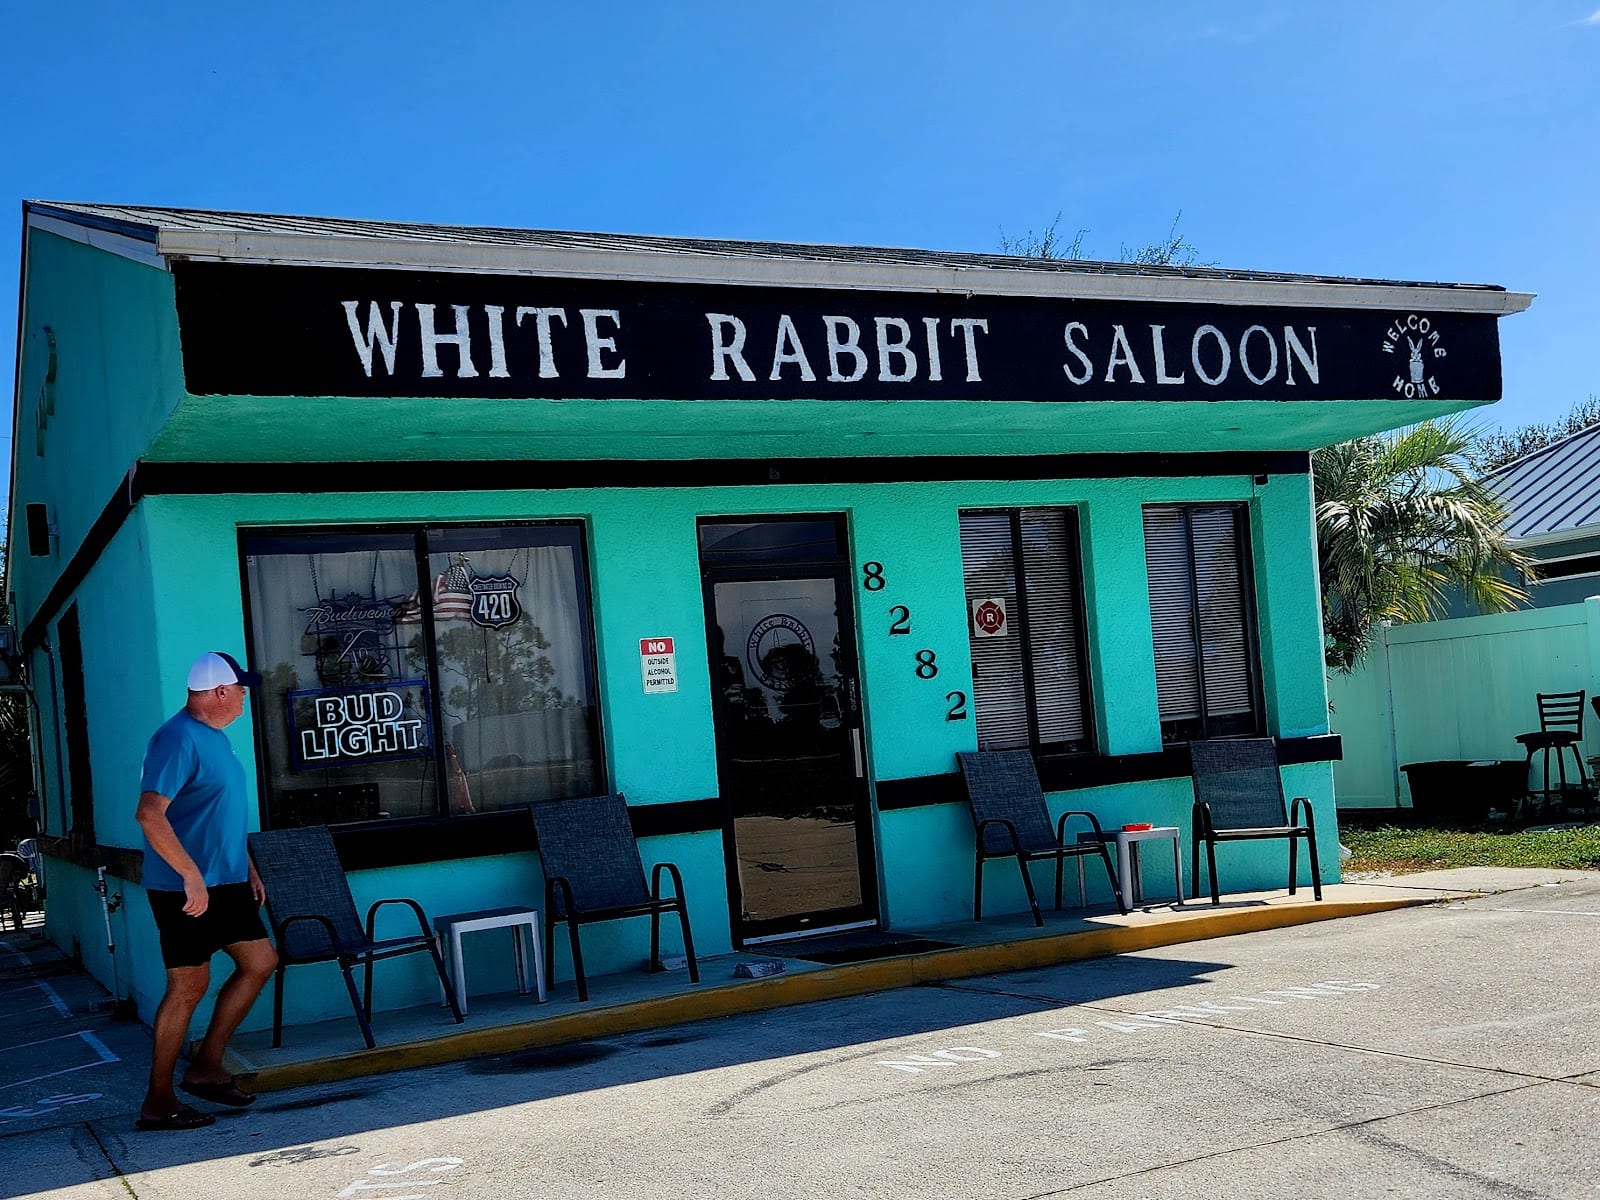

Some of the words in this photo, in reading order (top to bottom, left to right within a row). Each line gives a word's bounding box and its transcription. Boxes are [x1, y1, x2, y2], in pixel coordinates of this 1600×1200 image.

[340, 299, 627, 380] WHITE
[704, 312, 989, 384] RABBIT
[1062, 320, 1320, 386] SALOON
[1382, 314, 1447, 358] WELCOME
[1392, 375, 1440, 399] HOME
[478, 593, 511, 620] 420
[986, 613, 995, 623] R
[749, 619, 775, 649] White
[780, 617, 811, 649] Rabbit
[648, 641, 666, 653] NO
[647, 657, 669, 666] OUTSIDE
[647, 667, 672, 676] ALCOHOL
[646, 677, 674, 687] PERMITTED
[315, 692, 403, 728] BUD
[301, 719, 422, 760] LIGHT
[874, 1045, 1003, 1074] NO
